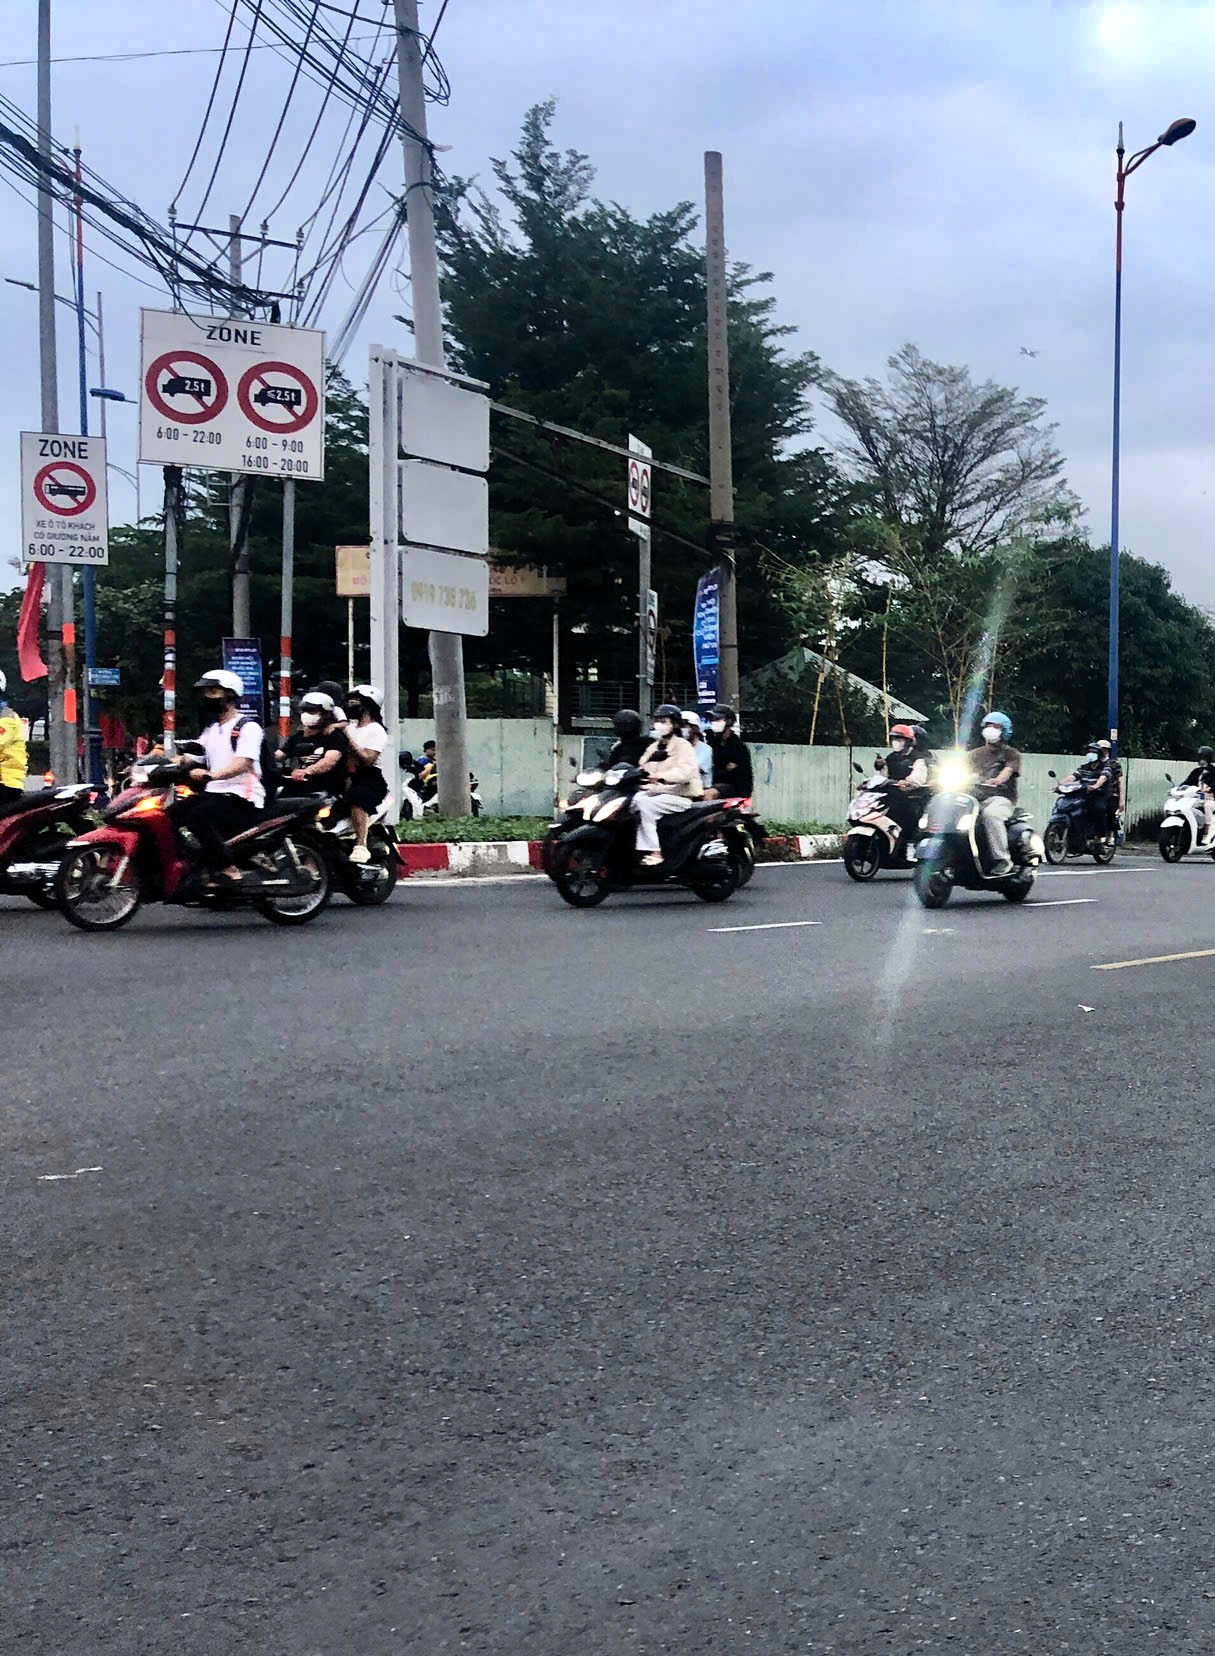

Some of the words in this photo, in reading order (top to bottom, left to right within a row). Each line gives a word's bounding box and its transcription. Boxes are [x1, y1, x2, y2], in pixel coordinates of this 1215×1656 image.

[206, 324, 262, 346] ZONE
[156, 426, 180, 441] 6:00
[192, 429, 222, 445] 22:00
[245, 436, 268, 450] 6:00
[281, 439, 304, 453] 9:00
[38, 438, 89, 459] ZONE
[242, 454, 269, 469] 16:00
[280, 458, 309, 473] 20:00
[36, 520, 47, 529] XE
[28, 543, 56, 557] 6:00
[68, 545, 105, 559] 22:00
